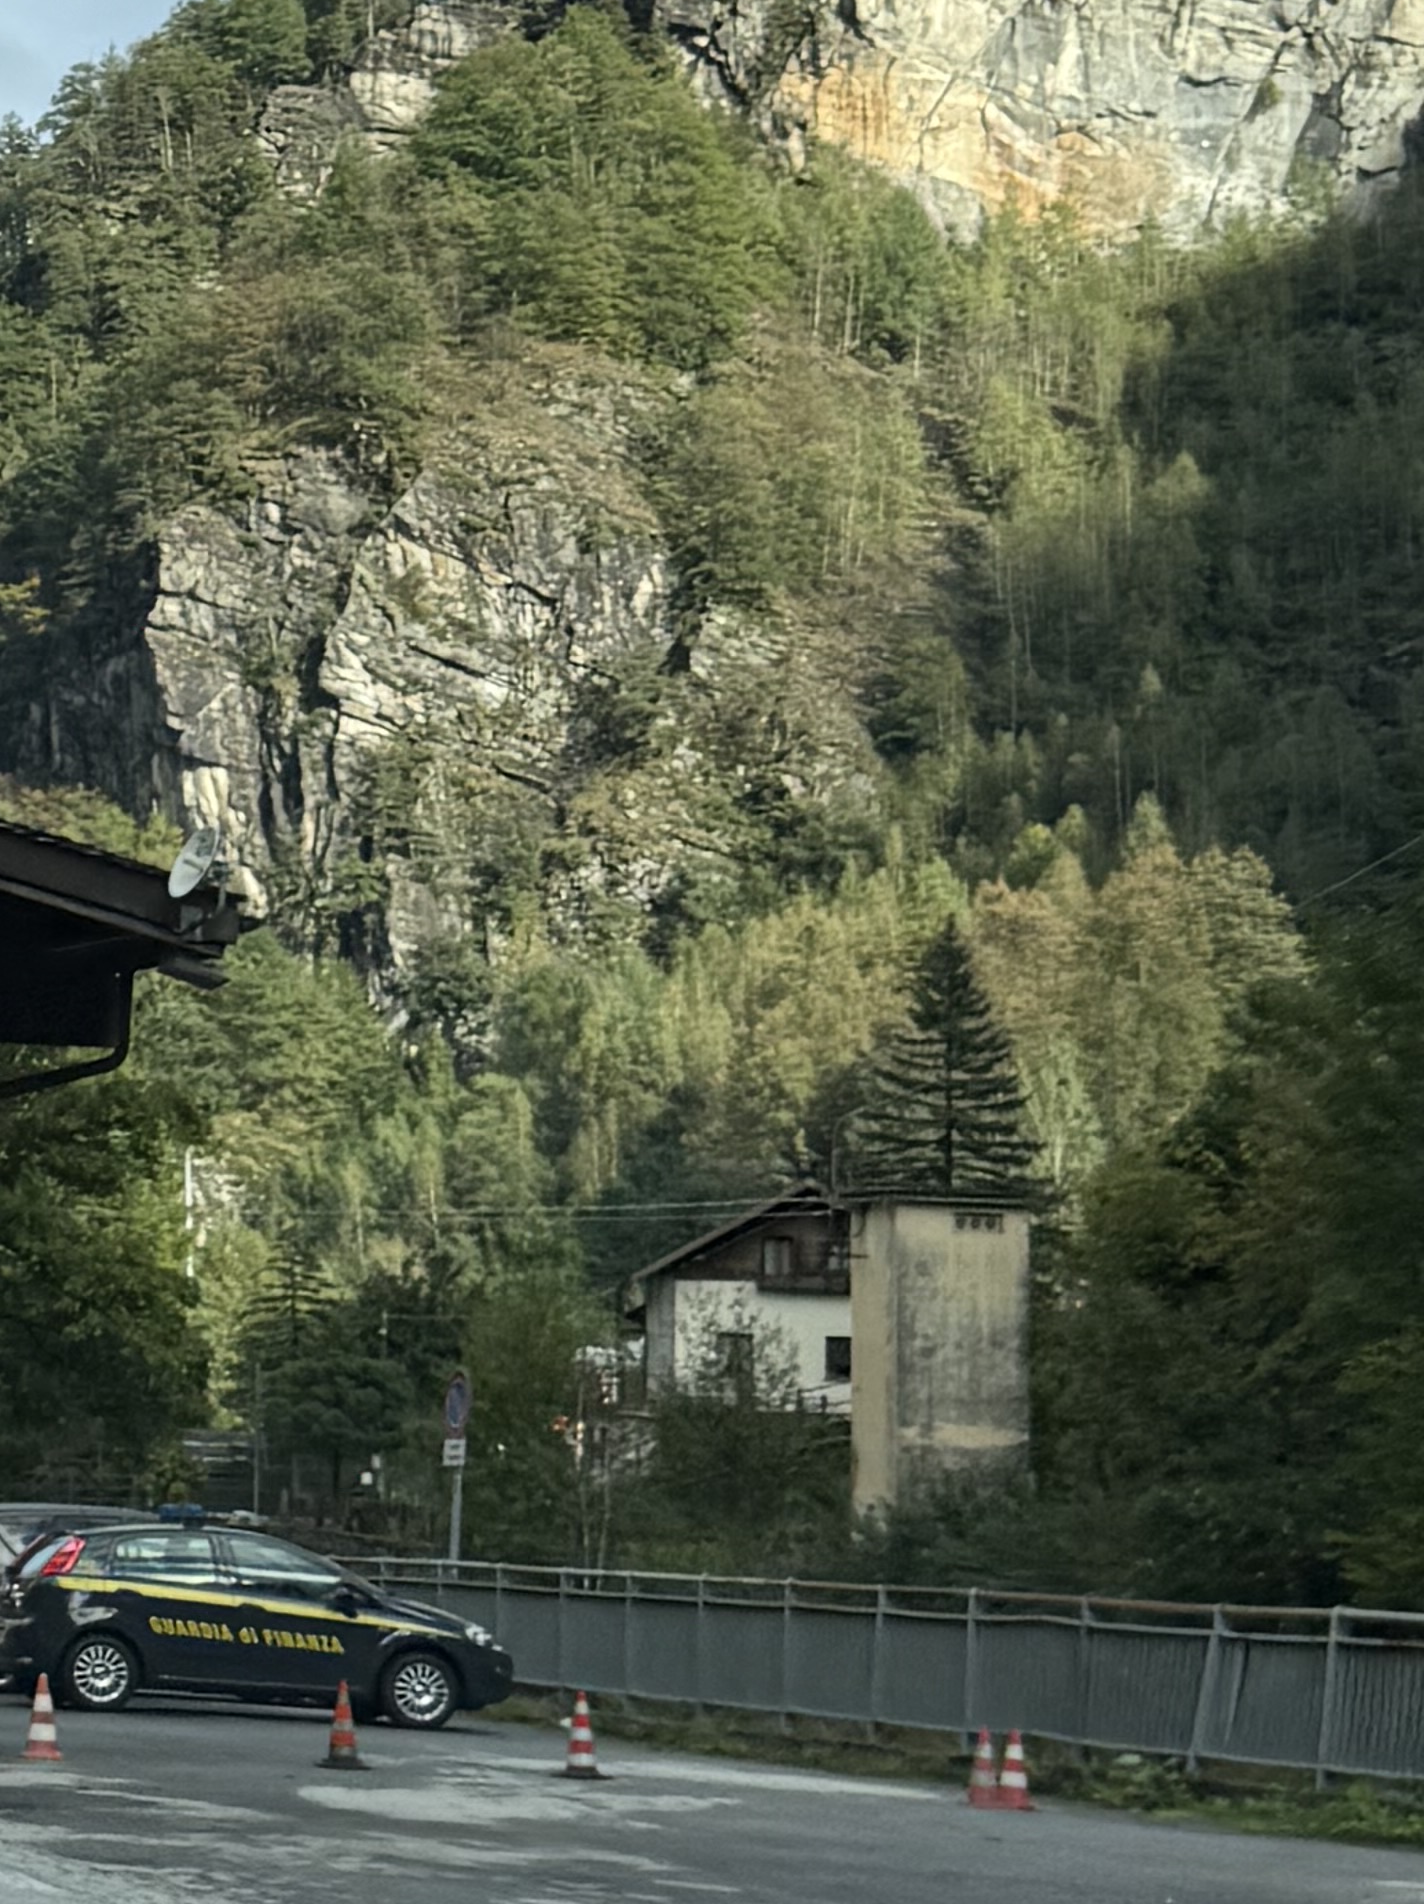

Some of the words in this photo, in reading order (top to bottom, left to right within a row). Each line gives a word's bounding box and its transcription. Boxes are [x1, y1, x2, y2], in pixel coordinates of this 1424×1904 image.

[149, 1615, 234, 1642] GUARDIA
[238, 1626, 259, 1645] di
[261, 1628, 345, 1656] FINANZA
